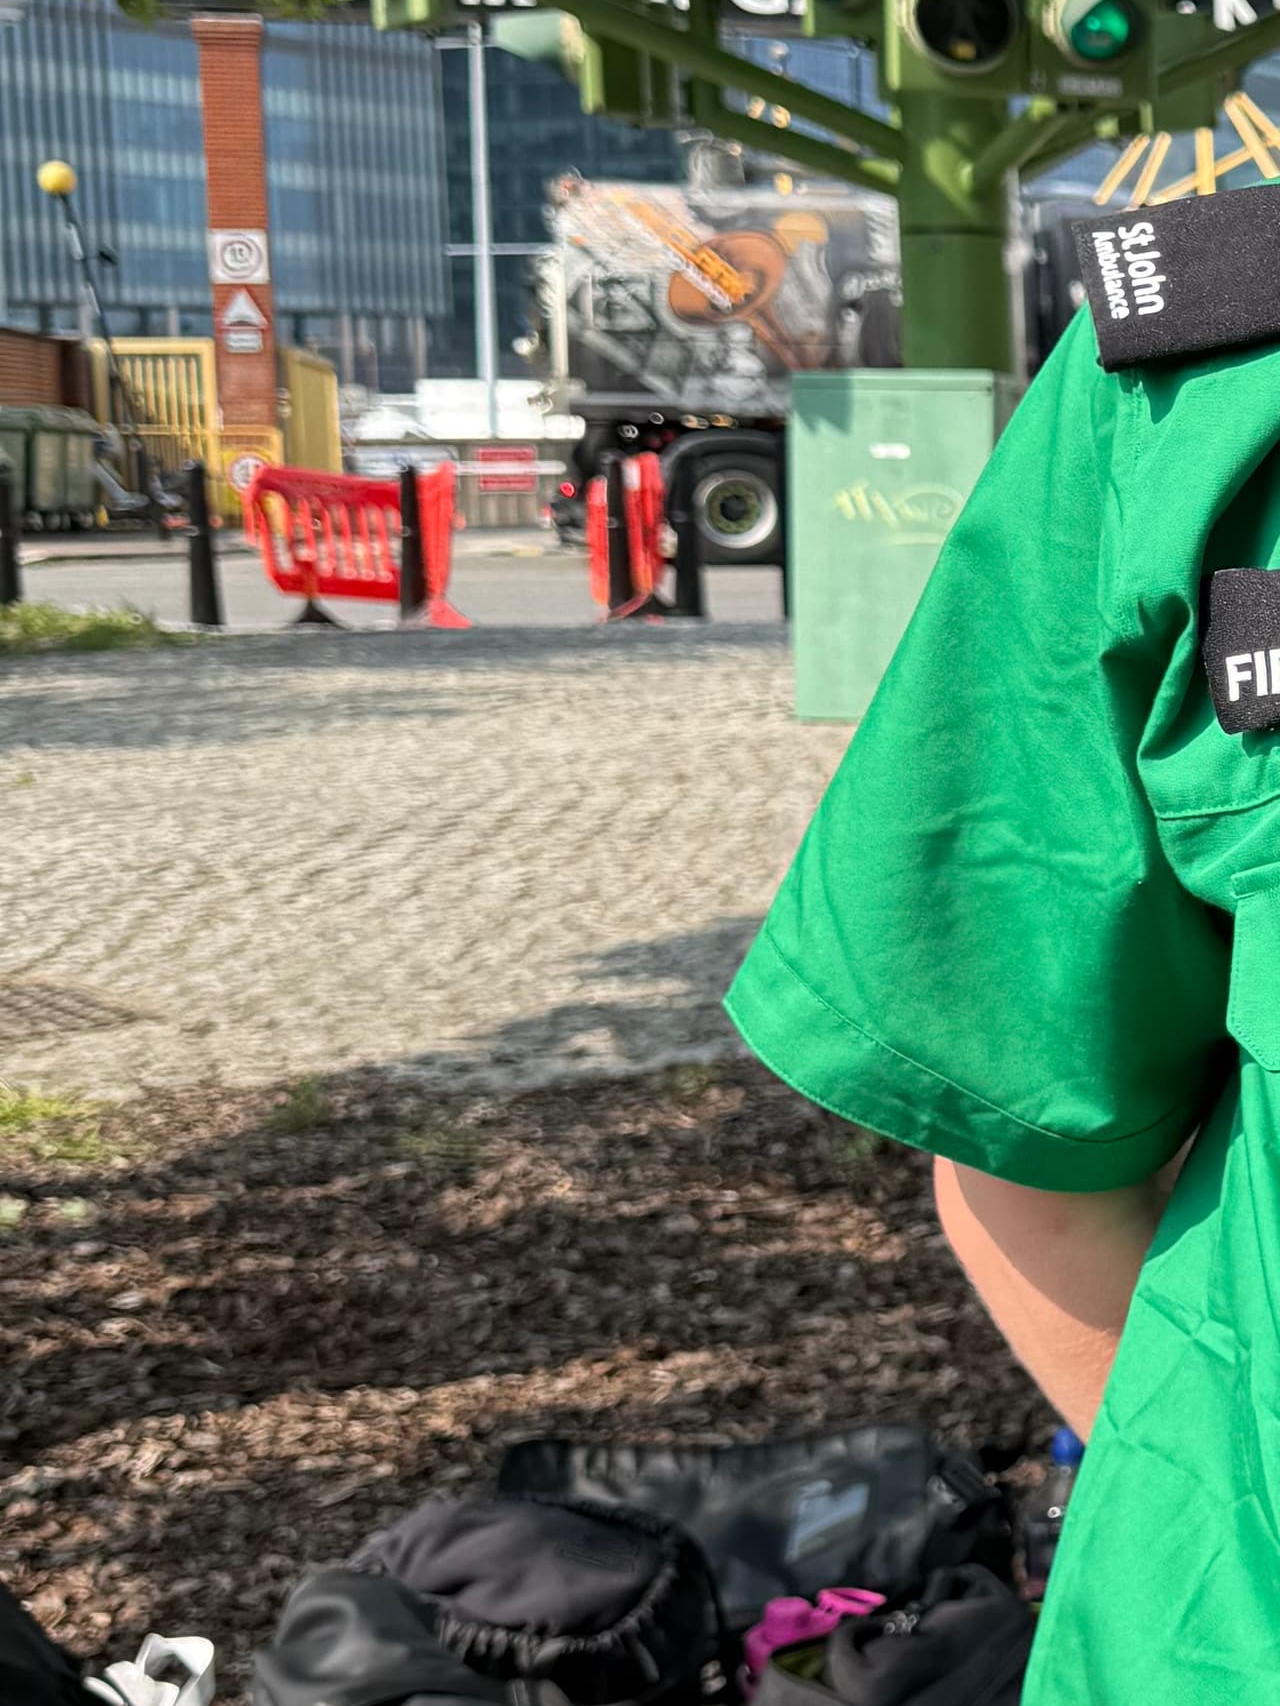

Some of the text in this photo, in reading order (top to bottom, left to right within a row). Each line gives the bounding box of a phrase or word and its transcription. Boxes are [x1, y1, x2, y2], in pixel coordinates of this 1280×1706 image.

[1091, 231, 1130, 320] Ambulance
[1117, 221, 1167, 316] St John
